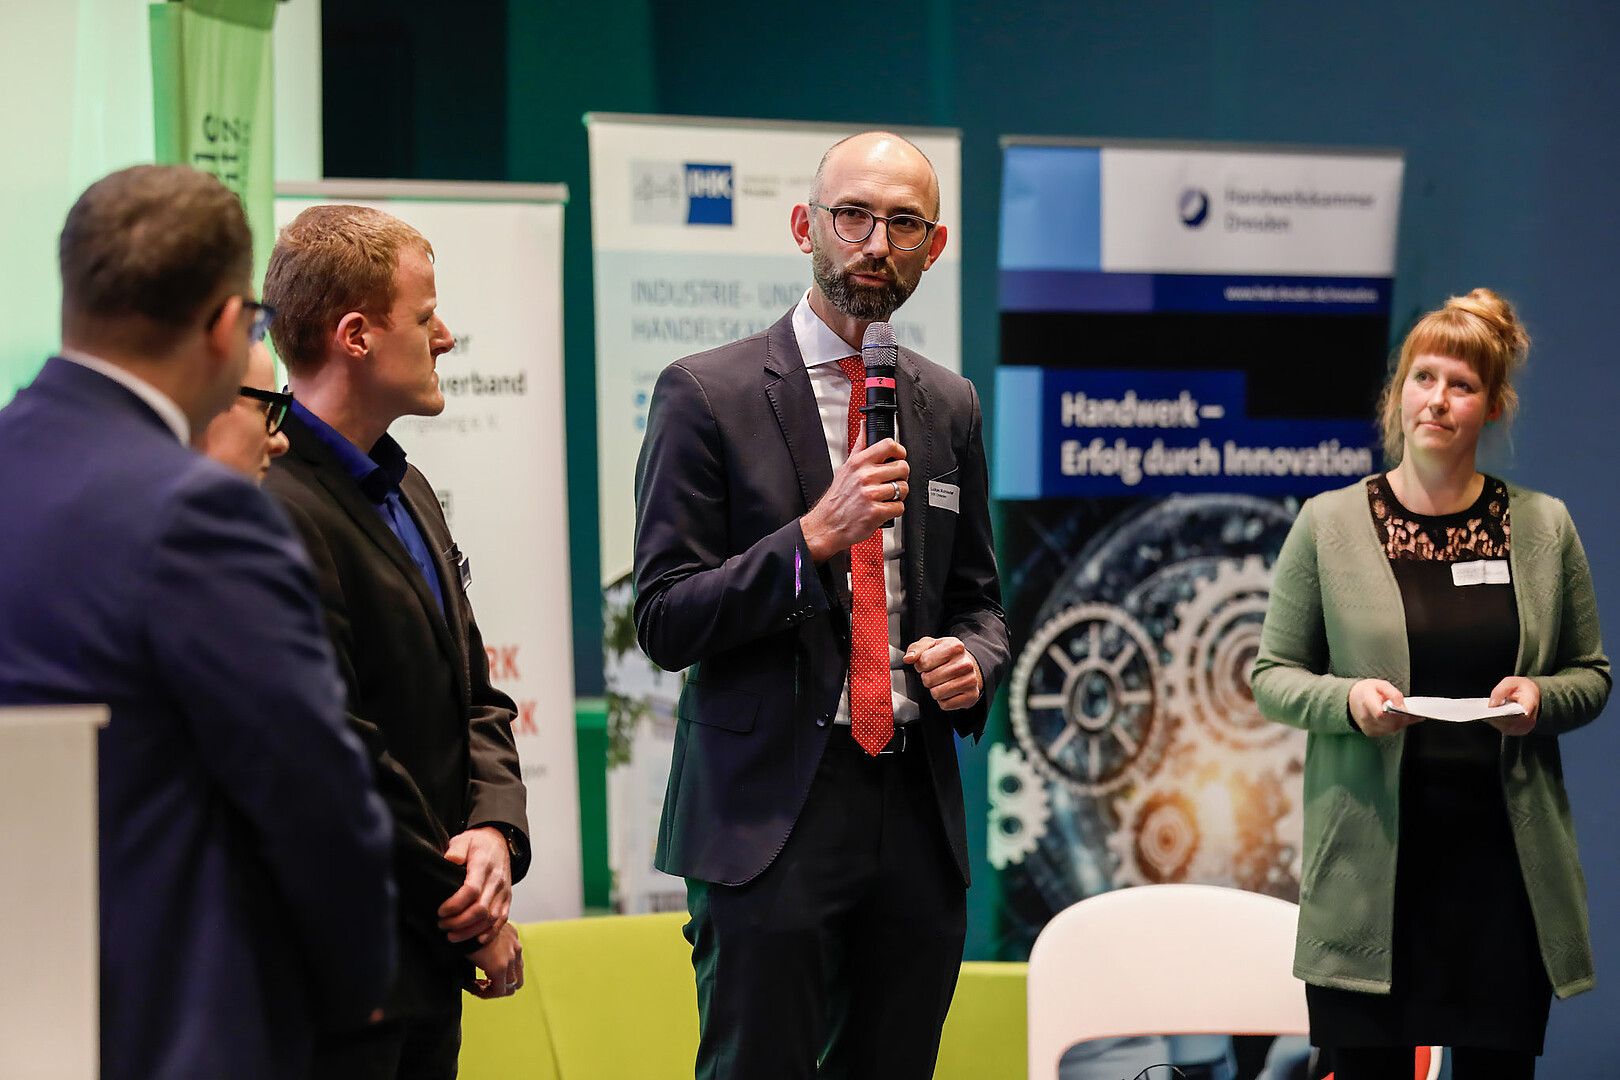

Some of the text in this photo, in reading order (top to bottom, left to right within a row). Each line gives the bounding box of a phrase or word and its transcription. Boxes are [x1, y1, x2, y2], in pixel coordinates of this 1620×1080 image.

[686, 168, 732, 199] IHK
[1225, 185, 1376, 208] Handwerkskammer
[1225, 211, 1291, 233] Dresden
[631, 280, 750, 305] INDUSTRIE-
[1061, 390, 1199, 428] Handwerk
[1061, 437, 1373, 486] Erfolg durch Innovation
